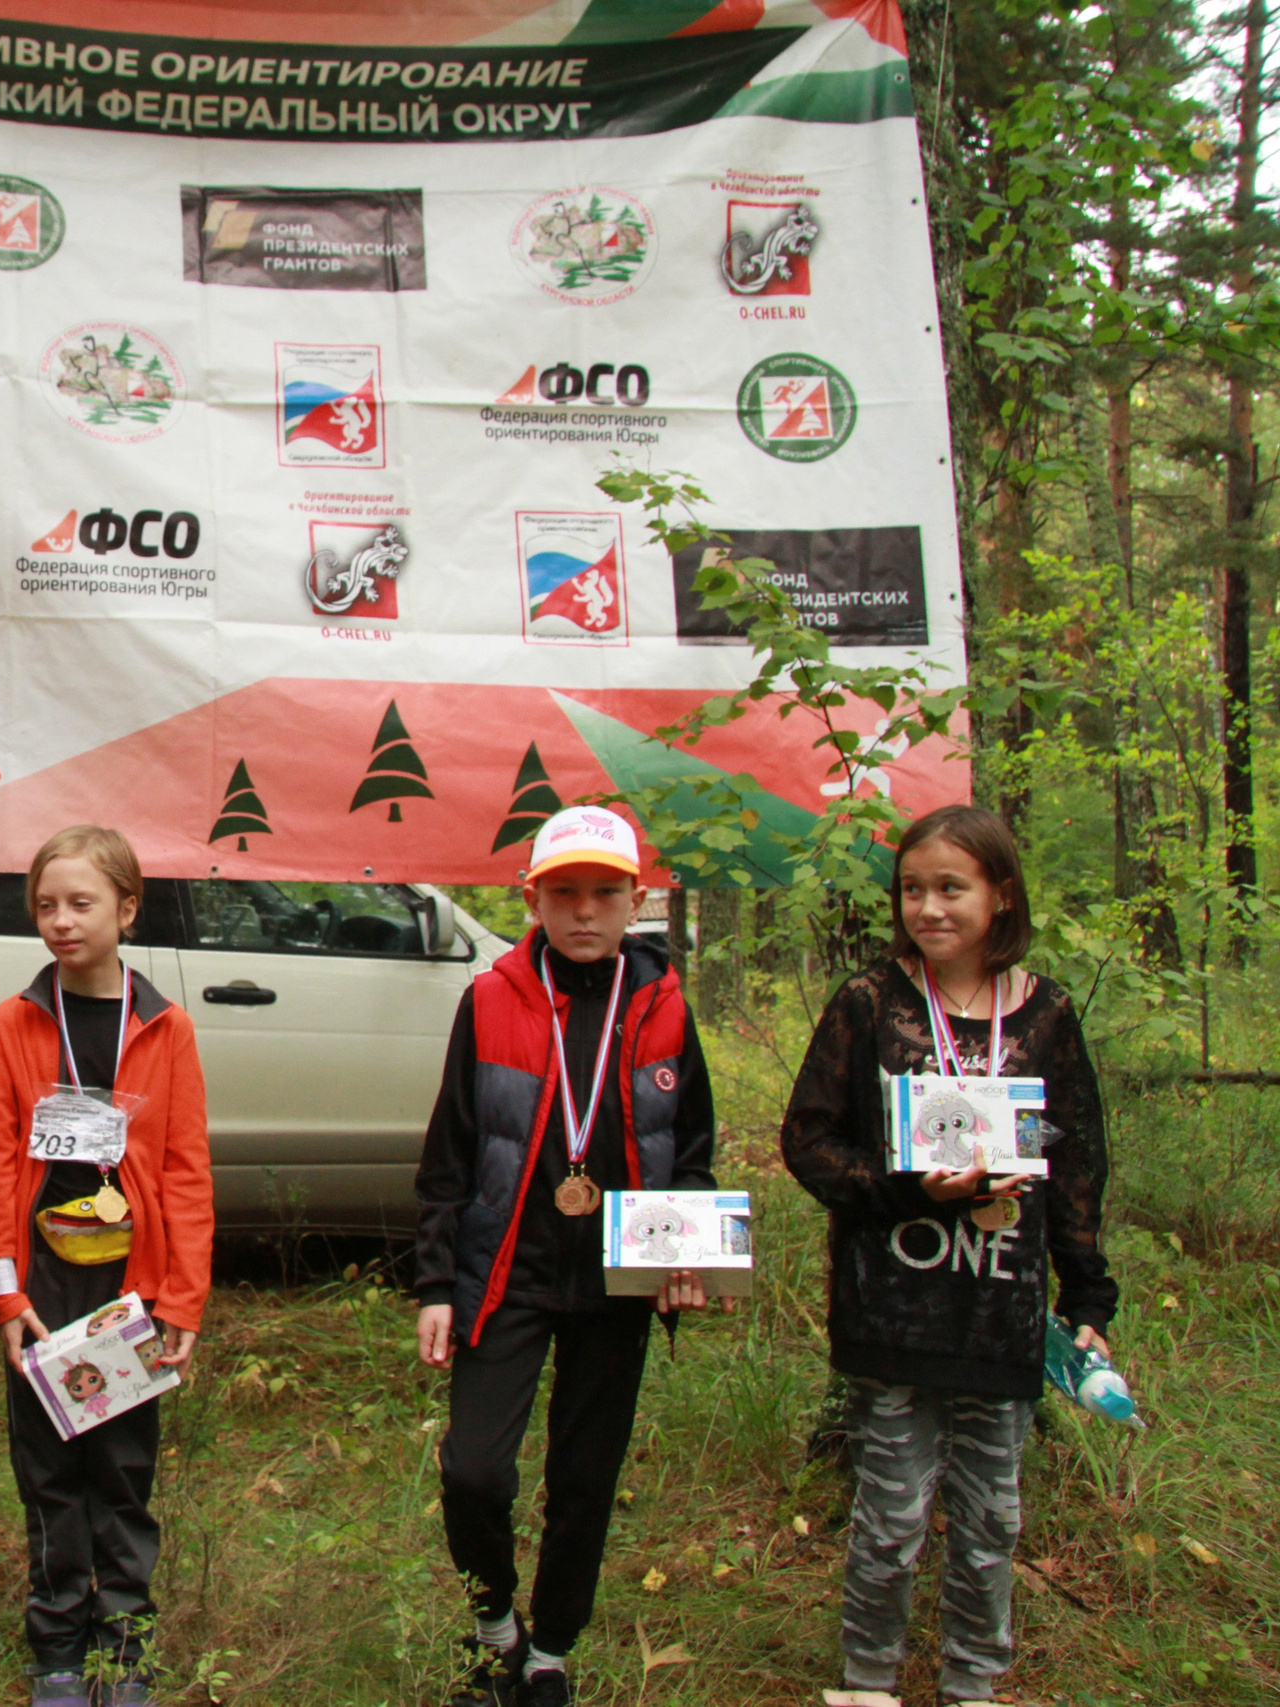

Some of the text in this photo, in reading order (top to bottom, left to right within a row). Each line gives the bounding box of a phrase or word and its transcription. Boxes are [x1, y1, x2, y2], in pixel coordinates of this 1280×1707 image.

[151, 51, 588, 89] ОРИЕНТИРОВАНИЕ
[97, 88, 439, 133] ФЕДЕРАЛЬНЫЙ
[453, 101, 591, 134] ОКРУГ
[262, 222, 314, 237] ФОНД
[263, 239, 408, 256] ПРЕЗИДЕНТСКИХ
[263, 257, 342, 272] ГРАНТОВ
[739, 306, 806, 320] O-CHEL.RU
[538, 362, 650, 407] ФСО
[480, 405, 667, 428] Федерация спортивного
[485, 426, 612, 444] ориентирования
[304, 490, 394, 502] Ориентирование
[366, 504, 412, 516] области
[78, 507, 200, 558] ФСО
[15, 555, 216, 582] Федерация спортивного
[20, 577, 208, 600] ориентирования Югры
[759, 590, 910, 608] ЗИДЕНТСКИХ
[321, 626, 391, 642] O-CHEL.RU
[34, 1132, 76, 1156] 703
[890, 1216, 1020, 1280] ONE
